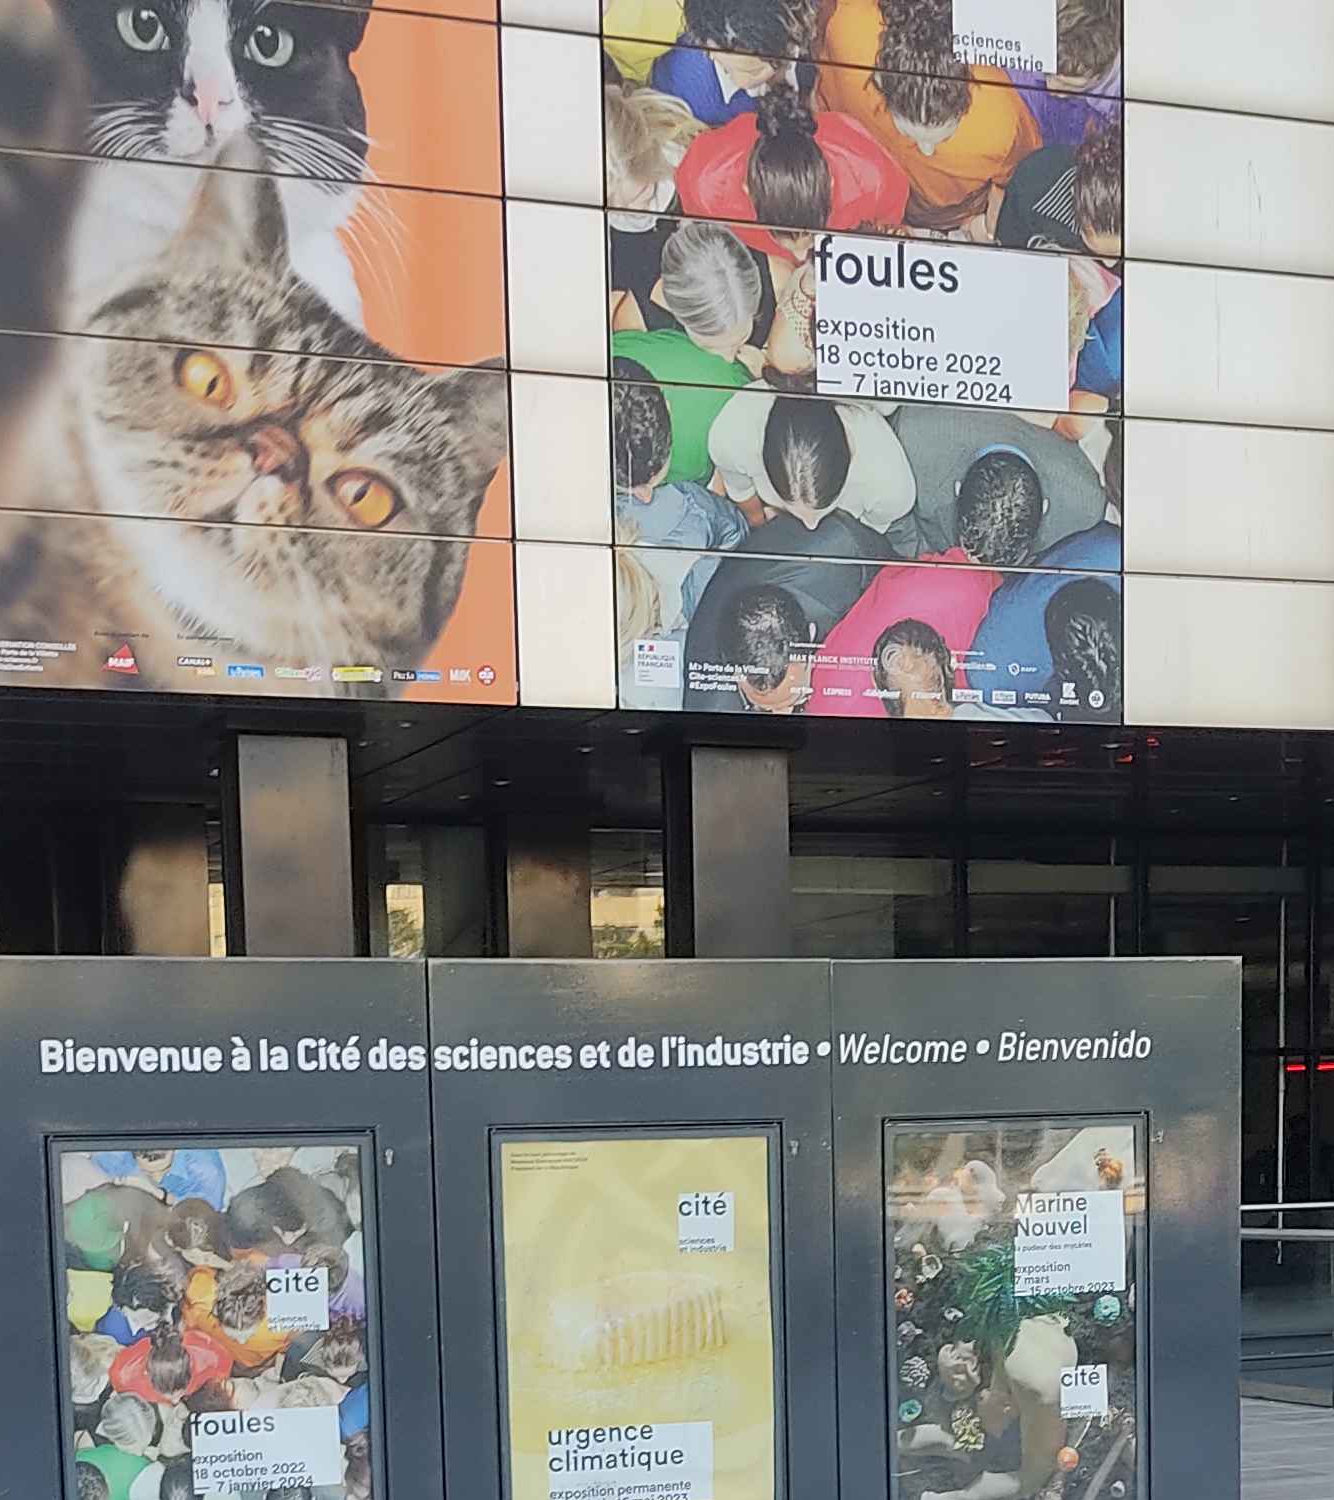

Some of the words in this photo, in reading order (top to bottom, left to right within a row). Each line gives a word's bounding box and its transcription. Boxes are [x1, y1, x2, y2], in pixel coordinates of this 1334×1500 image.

[952, 31, 1021, 52] sciences
[974, 48, 1044, 72] industrie
[815, 236, 959, 293] foules
[816, 317, 935, 343] exposition
[816, 344, 840, 364] 18
[848, 348, 938, 371] octobre
[945, 353, 1002, 376] 2022
[852, 374, 866, 393] 7
[873, 373, 949, 398] janvier
[956, 381, 1013, 403] 2024
[40, 1038, 223, 1073] Bienvenue
[230, 1036, 252, 1072] à
[259, 1038, 289, 1071] la
[296, 1035, 361, 1071] Cité
[368, 1038, 427, 1070] des
[434, 1037, 573, 1071] sciences
[579, 1040, 611, 1068] et
[617, 1037, 655, 1068] de
[662, 1034, 809, 1067] l'industrie
[839, 1033, 967, 1064] Welcome
[997, 1029, 1152, 1062] Bienvenido
[679, 1192, 727, 1217] cité
[1015, 1192, 1087, 1214] Marine
[1014, 1214, 1088, 1237] Nouvel
[1015, 1261, 1071, 1275] exposition
[266, 1267, 319, 1294] cité
[1024, 1275, 1050, 1285] mars
[1030, 1286, 1042, 1296] 15
[1044, 1283, 1085, 1295] octobre
[1087, 1281, 1115, 1293] 2023
[1060, 1365, 1100, 1387] cité
[190, 1410, 275, 1436] foules
[548, 1424, 653, 1450] urgence
[193, 1450, 263, 1466] exposition
[548, 1445, 684, 1472] climatique
[193, 1468, 208, 1480] 18
[213, 1465, 268, 1478] octobre
[272, 1462, 306, 1475] 2022
[216, 1481, 225, 1493] 7
[228, 1478, 275, 1494] janvier
[278, 1475, 314, 1490] 2024
[617, 1480, 692, 1497] permanente
